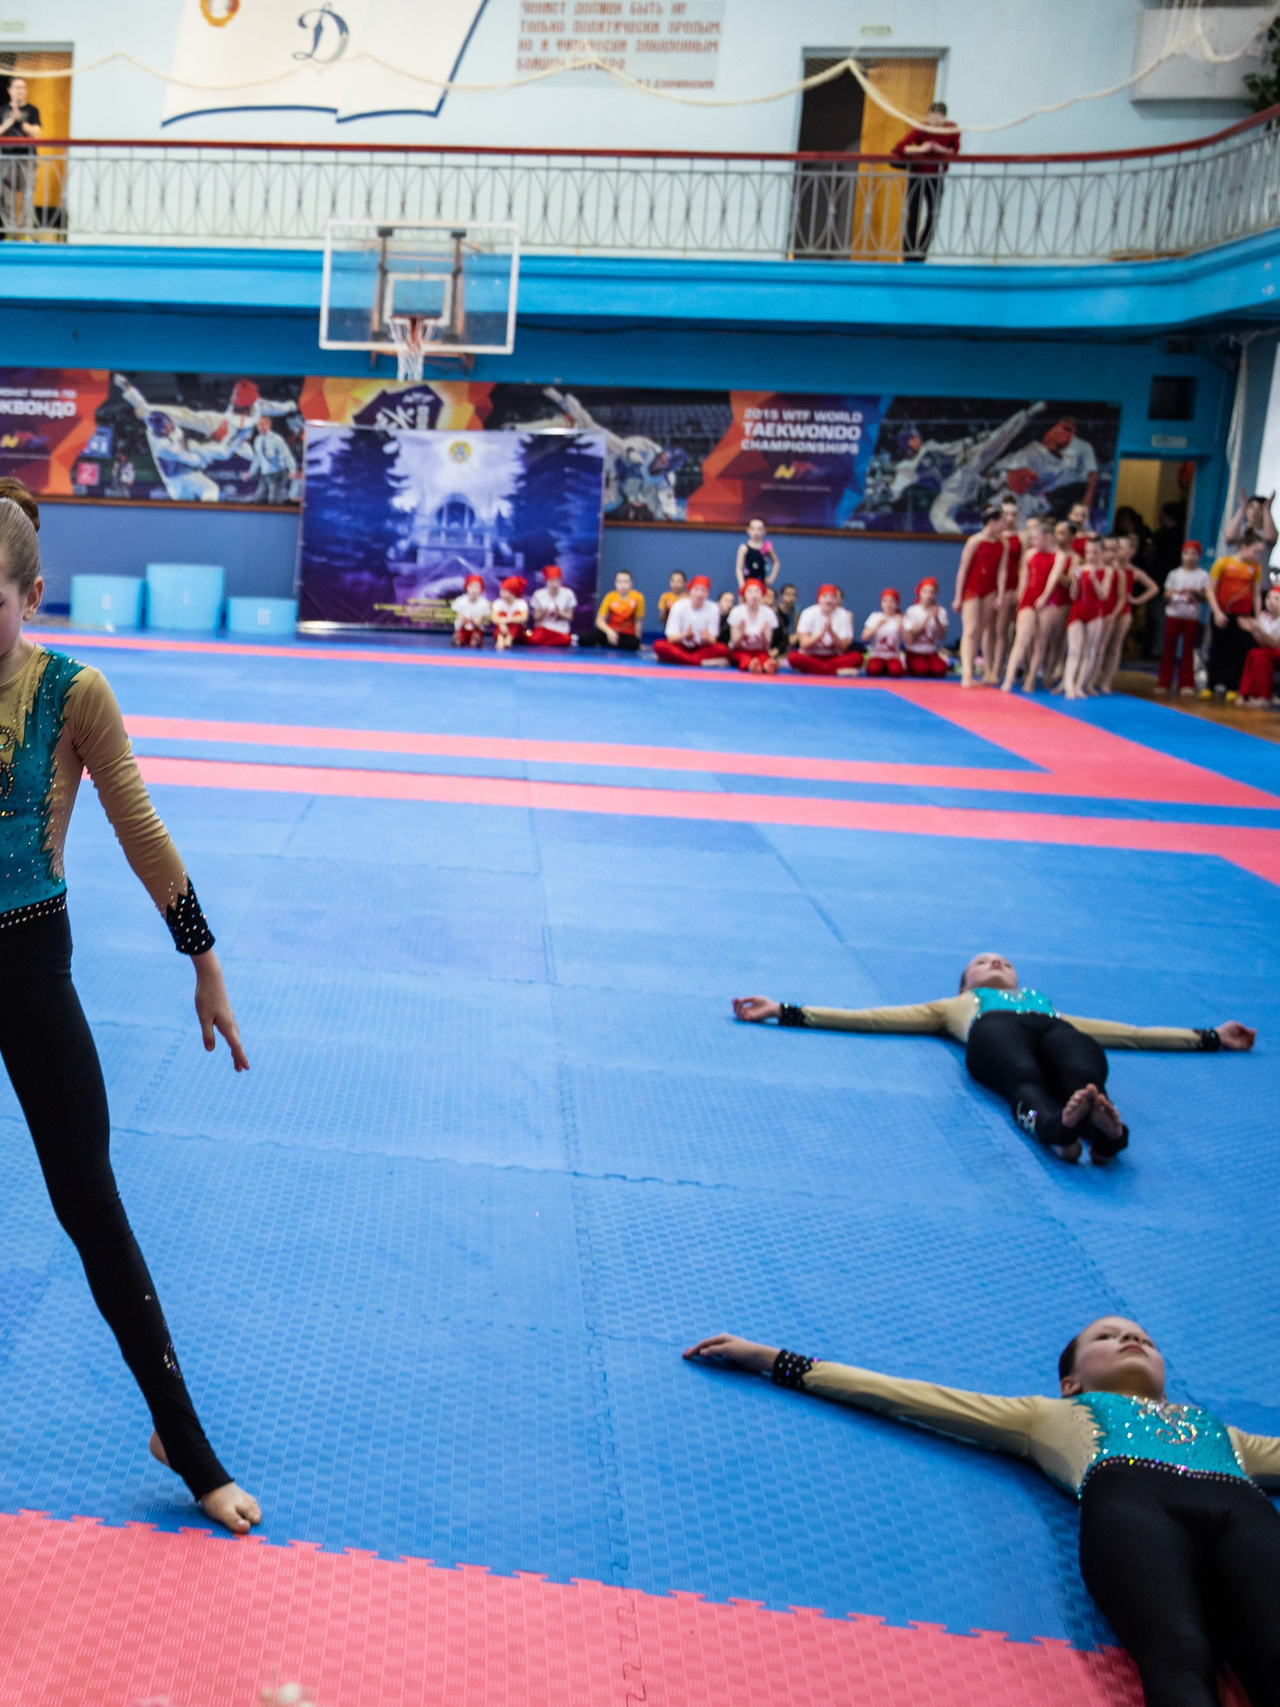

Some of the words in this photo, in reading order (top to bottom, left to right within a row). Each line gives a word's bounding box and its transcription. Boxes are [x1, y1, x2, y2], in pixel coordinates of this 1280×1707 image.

[629, 3, 664, 15] БЫТЬ
[671, 3, 687, 15] НЕ
[520, 21, 566, 33] ТОЛЬКО
[782, 409, 811, 421] WTF
[814, 411, 863, 424] WORLD
[742, 421, 862, 440] TAEKWONDO
[740, 438, 860, 455] CHAMPIONSHIPS
